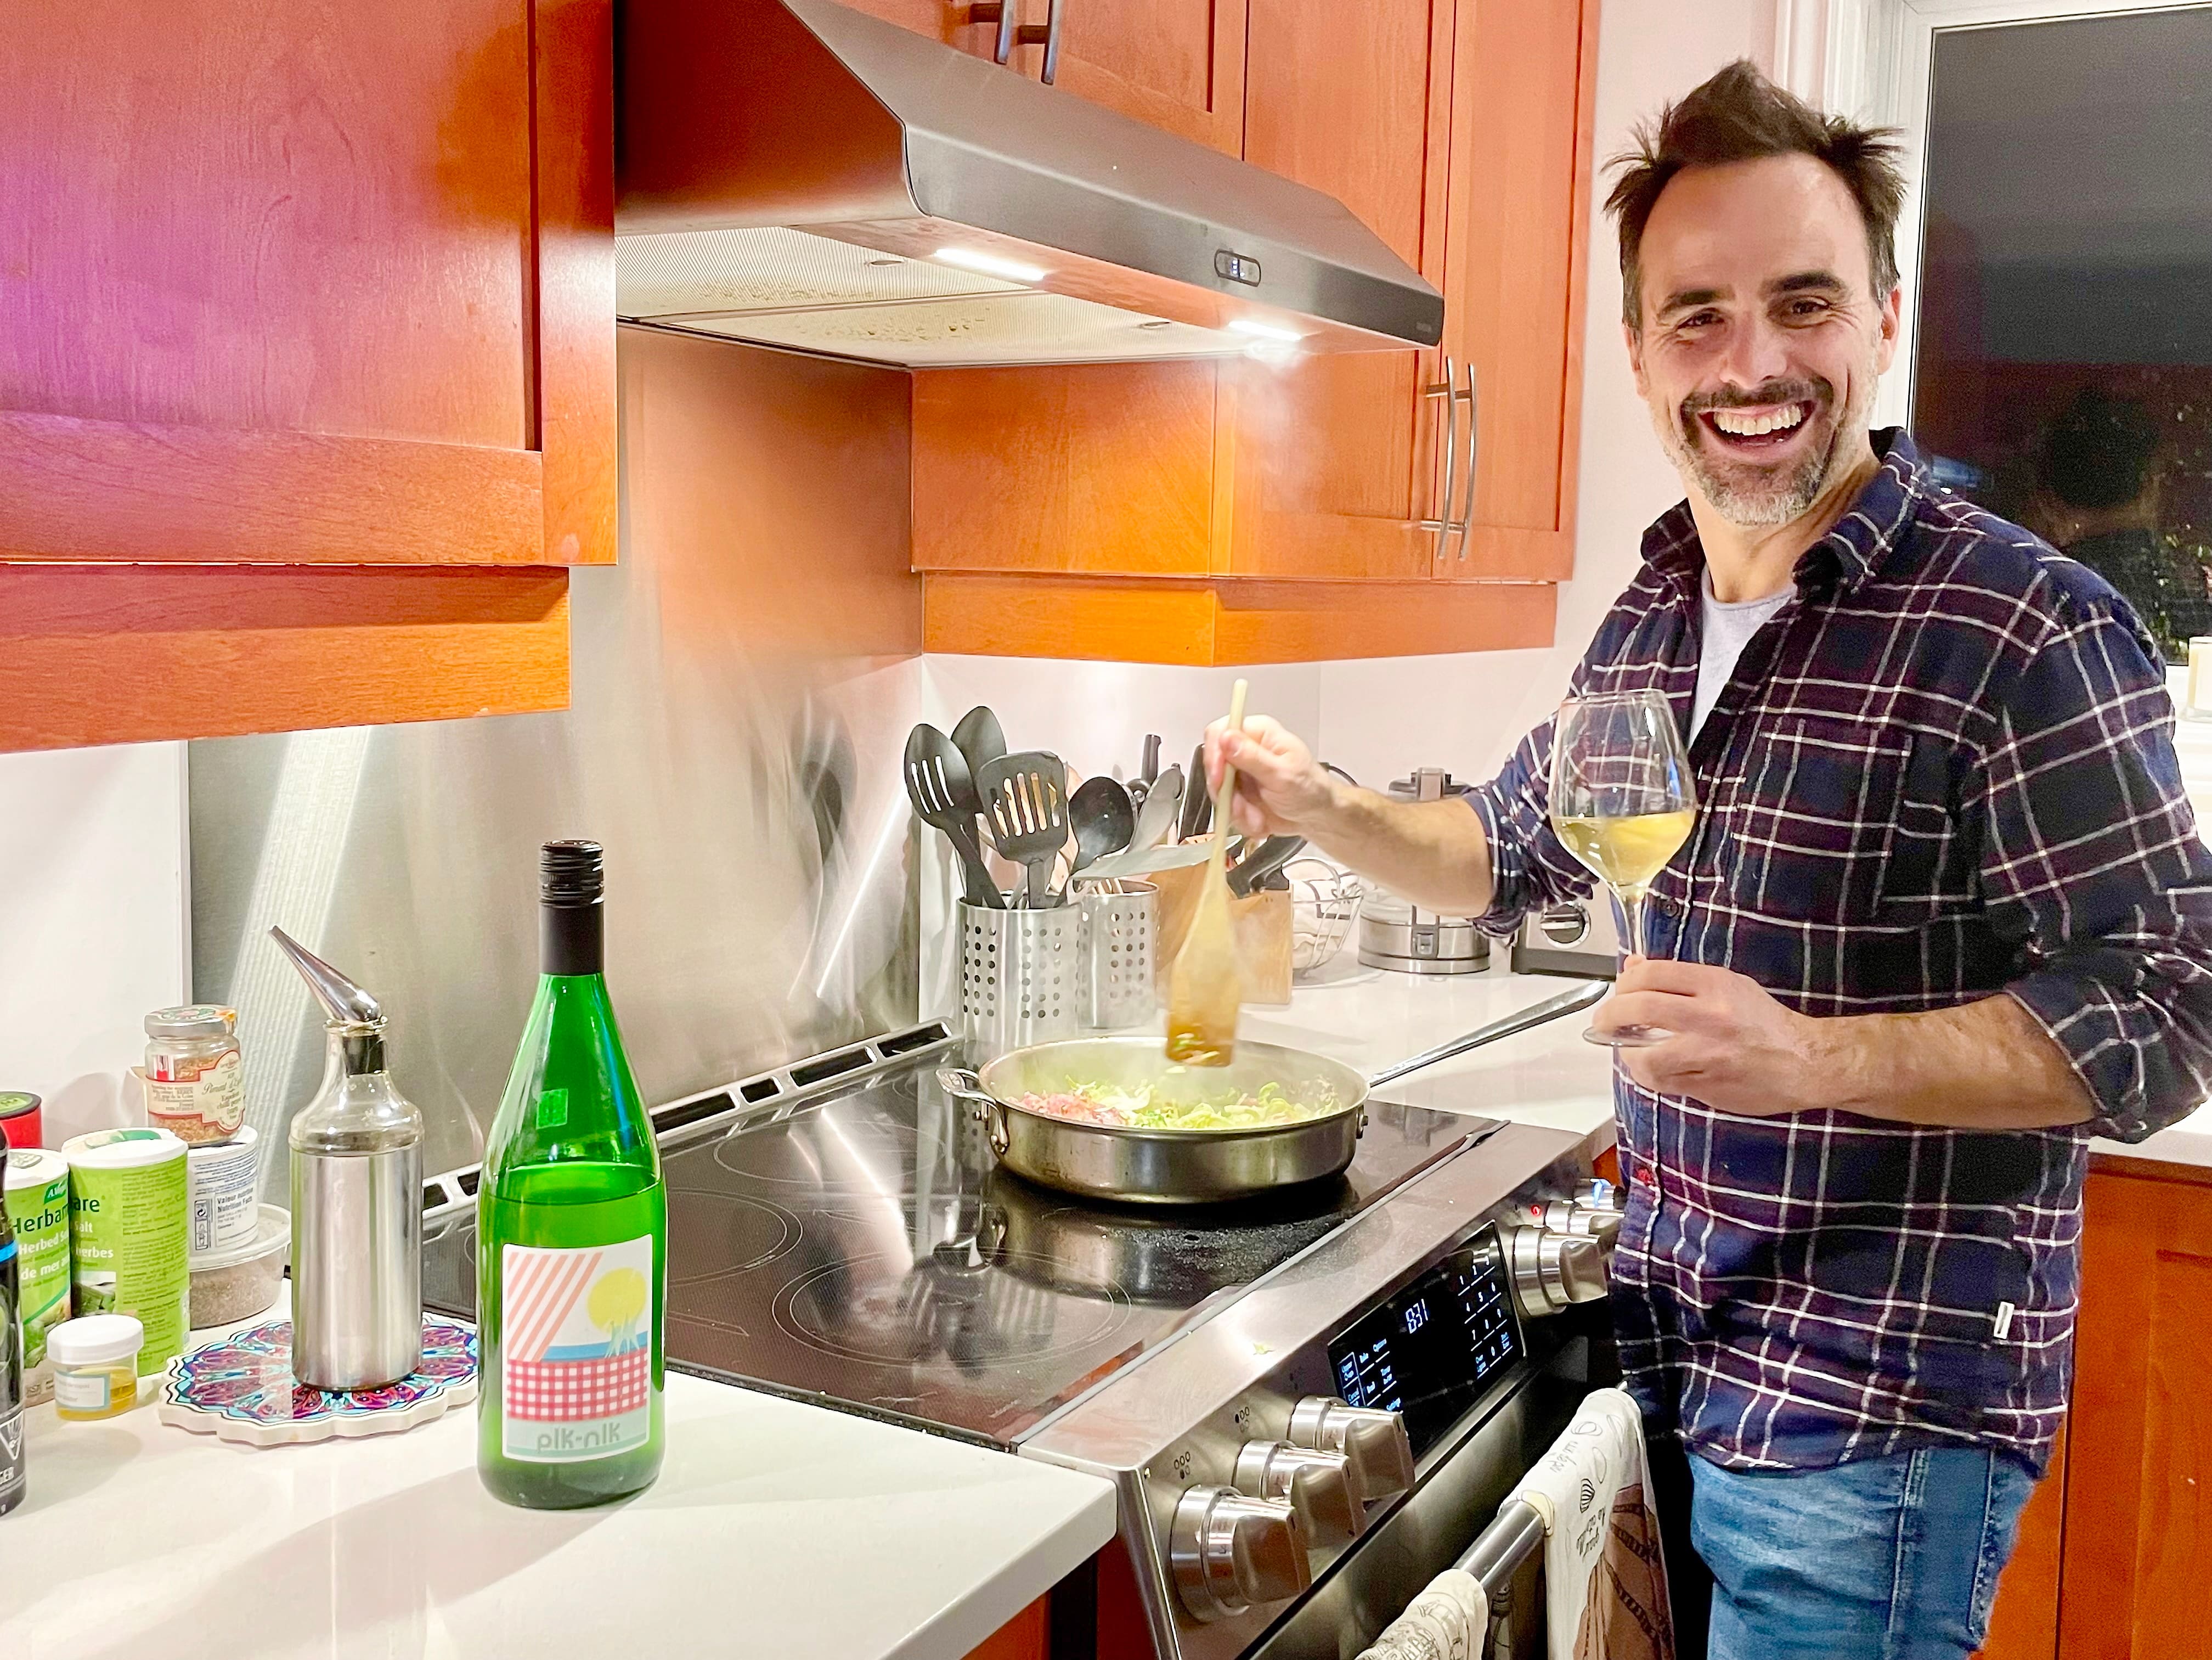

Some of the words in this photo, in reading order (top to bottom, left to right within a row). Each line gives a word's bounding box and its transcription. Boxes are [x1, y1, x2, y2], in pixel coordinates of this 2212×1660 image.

[18, 1232, 59, 1256] Herbed
[20, 1267, 37, 1280] de
[40, 1261, 60, 1276] mer
